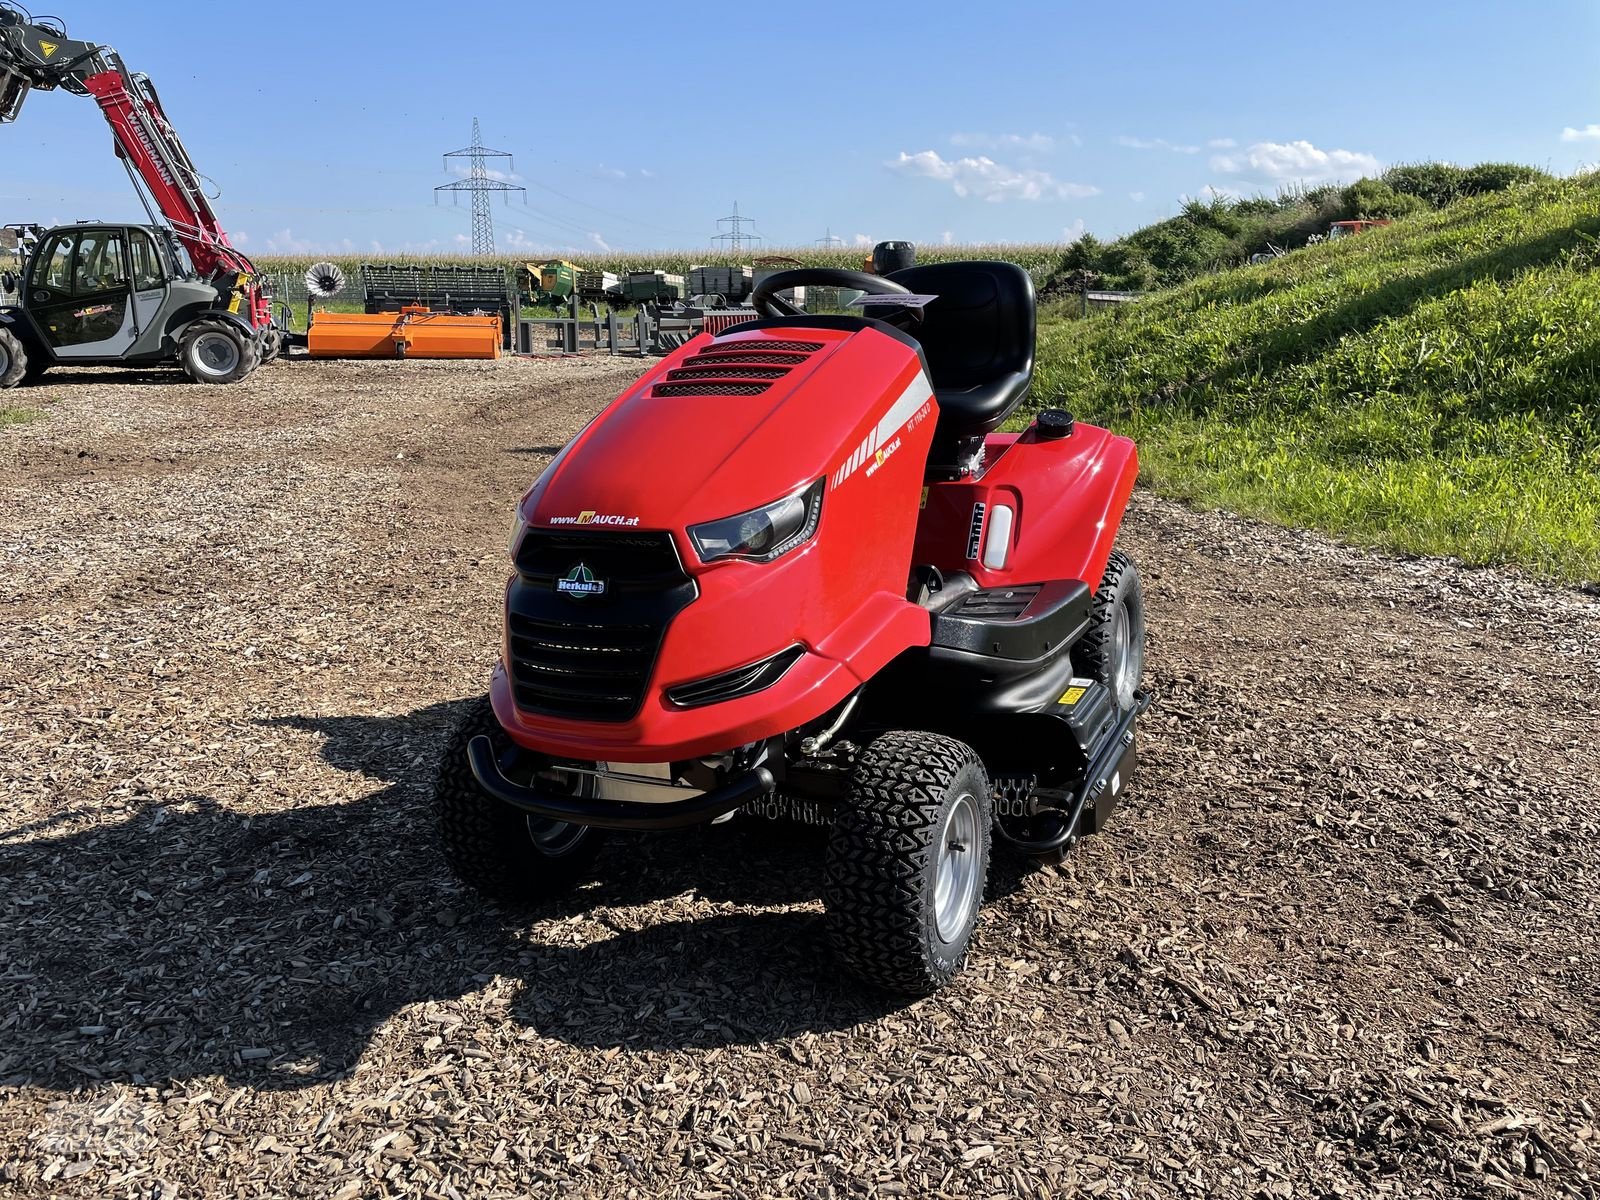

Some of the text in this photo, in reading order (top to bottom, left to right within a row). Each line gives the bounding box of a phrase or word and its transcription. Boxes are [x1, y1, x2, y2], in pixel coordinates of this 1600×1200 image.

[127, 111, 174, 186] WEIDEMANN
[865, 436, 901, 478] www.MAUCH.at
[550, 511, 639, 525] www.MAUCH.at
[558, 581, 602, 592] Herkules
